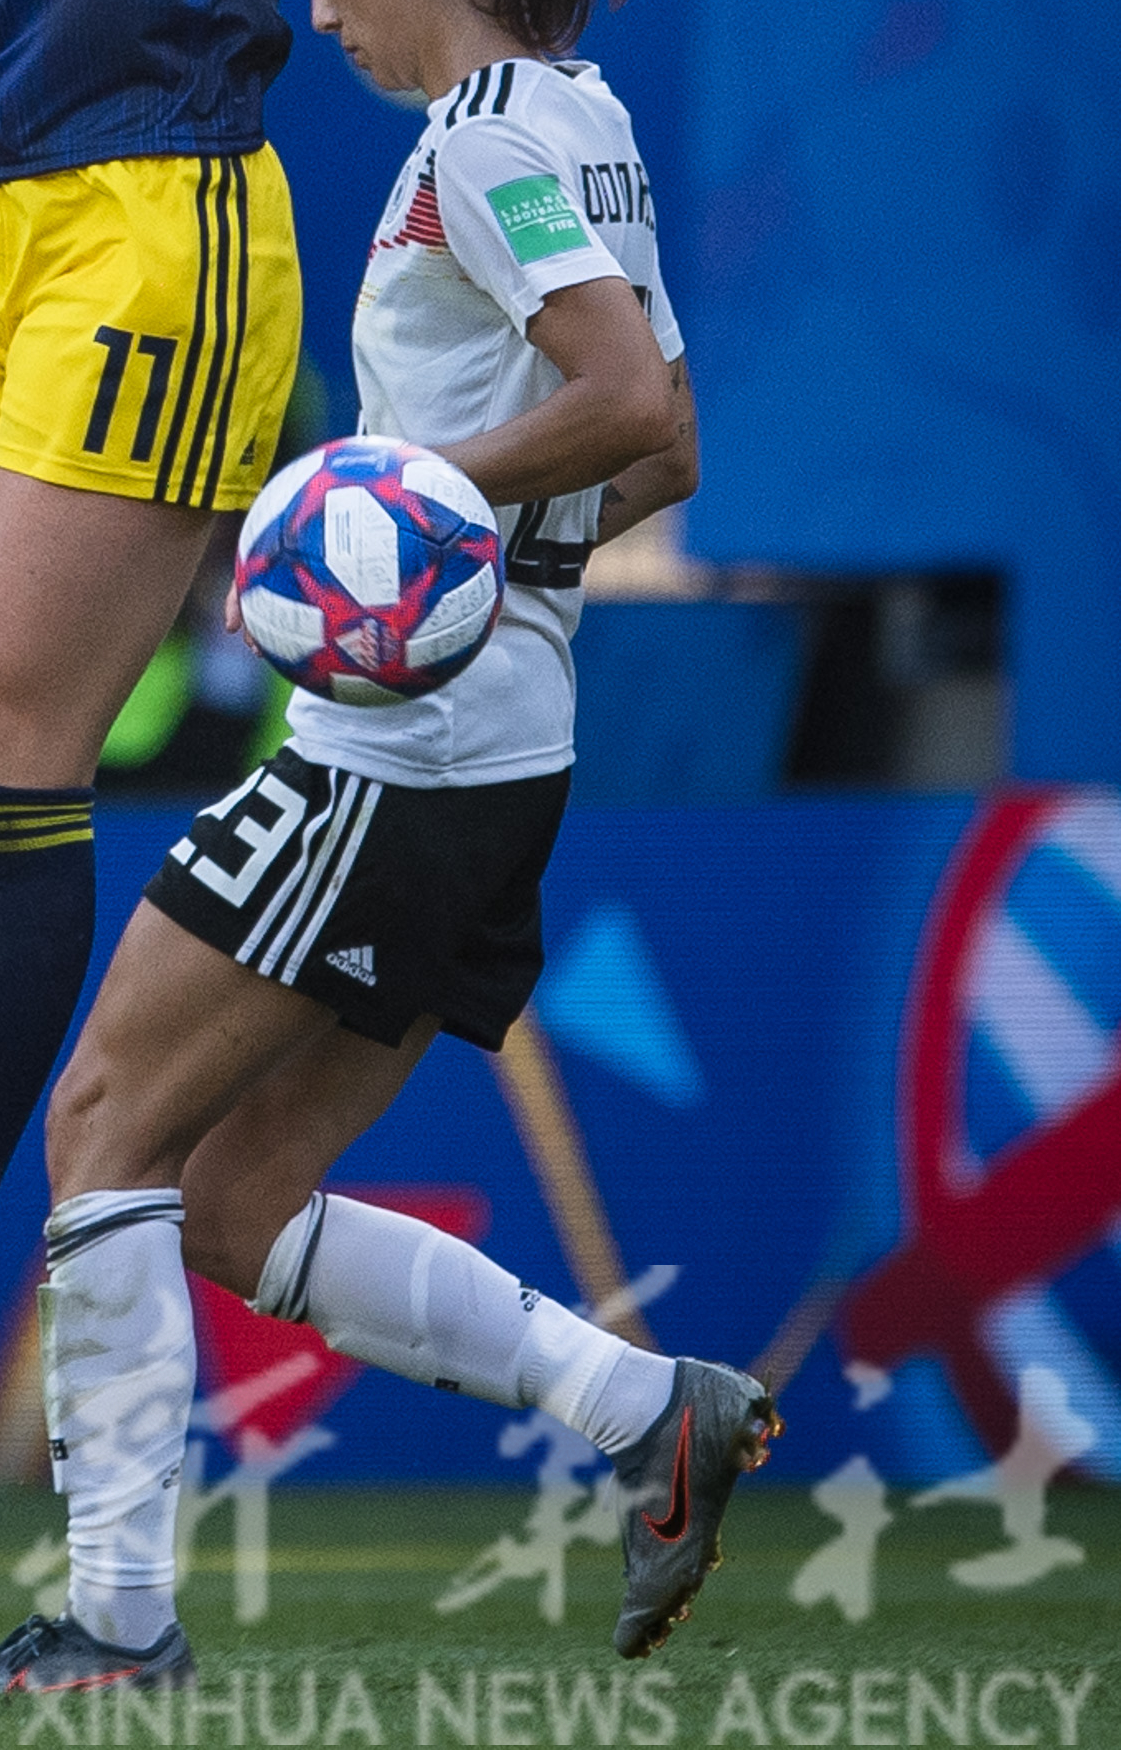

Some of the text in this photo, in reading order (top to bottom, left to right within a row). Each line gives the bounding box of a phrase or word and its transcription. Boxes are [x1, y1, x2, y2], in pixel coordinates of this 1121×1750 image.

[500, 194, 566, 219] LIVING
[579, 161, 655, 232] DOOR
[504, 202, 571, 228] FOOTBALL
[546, 218, 578, 234] FIFA
[82, 323, 179, 463] 11
[325, 952, 377, 987] adidas
